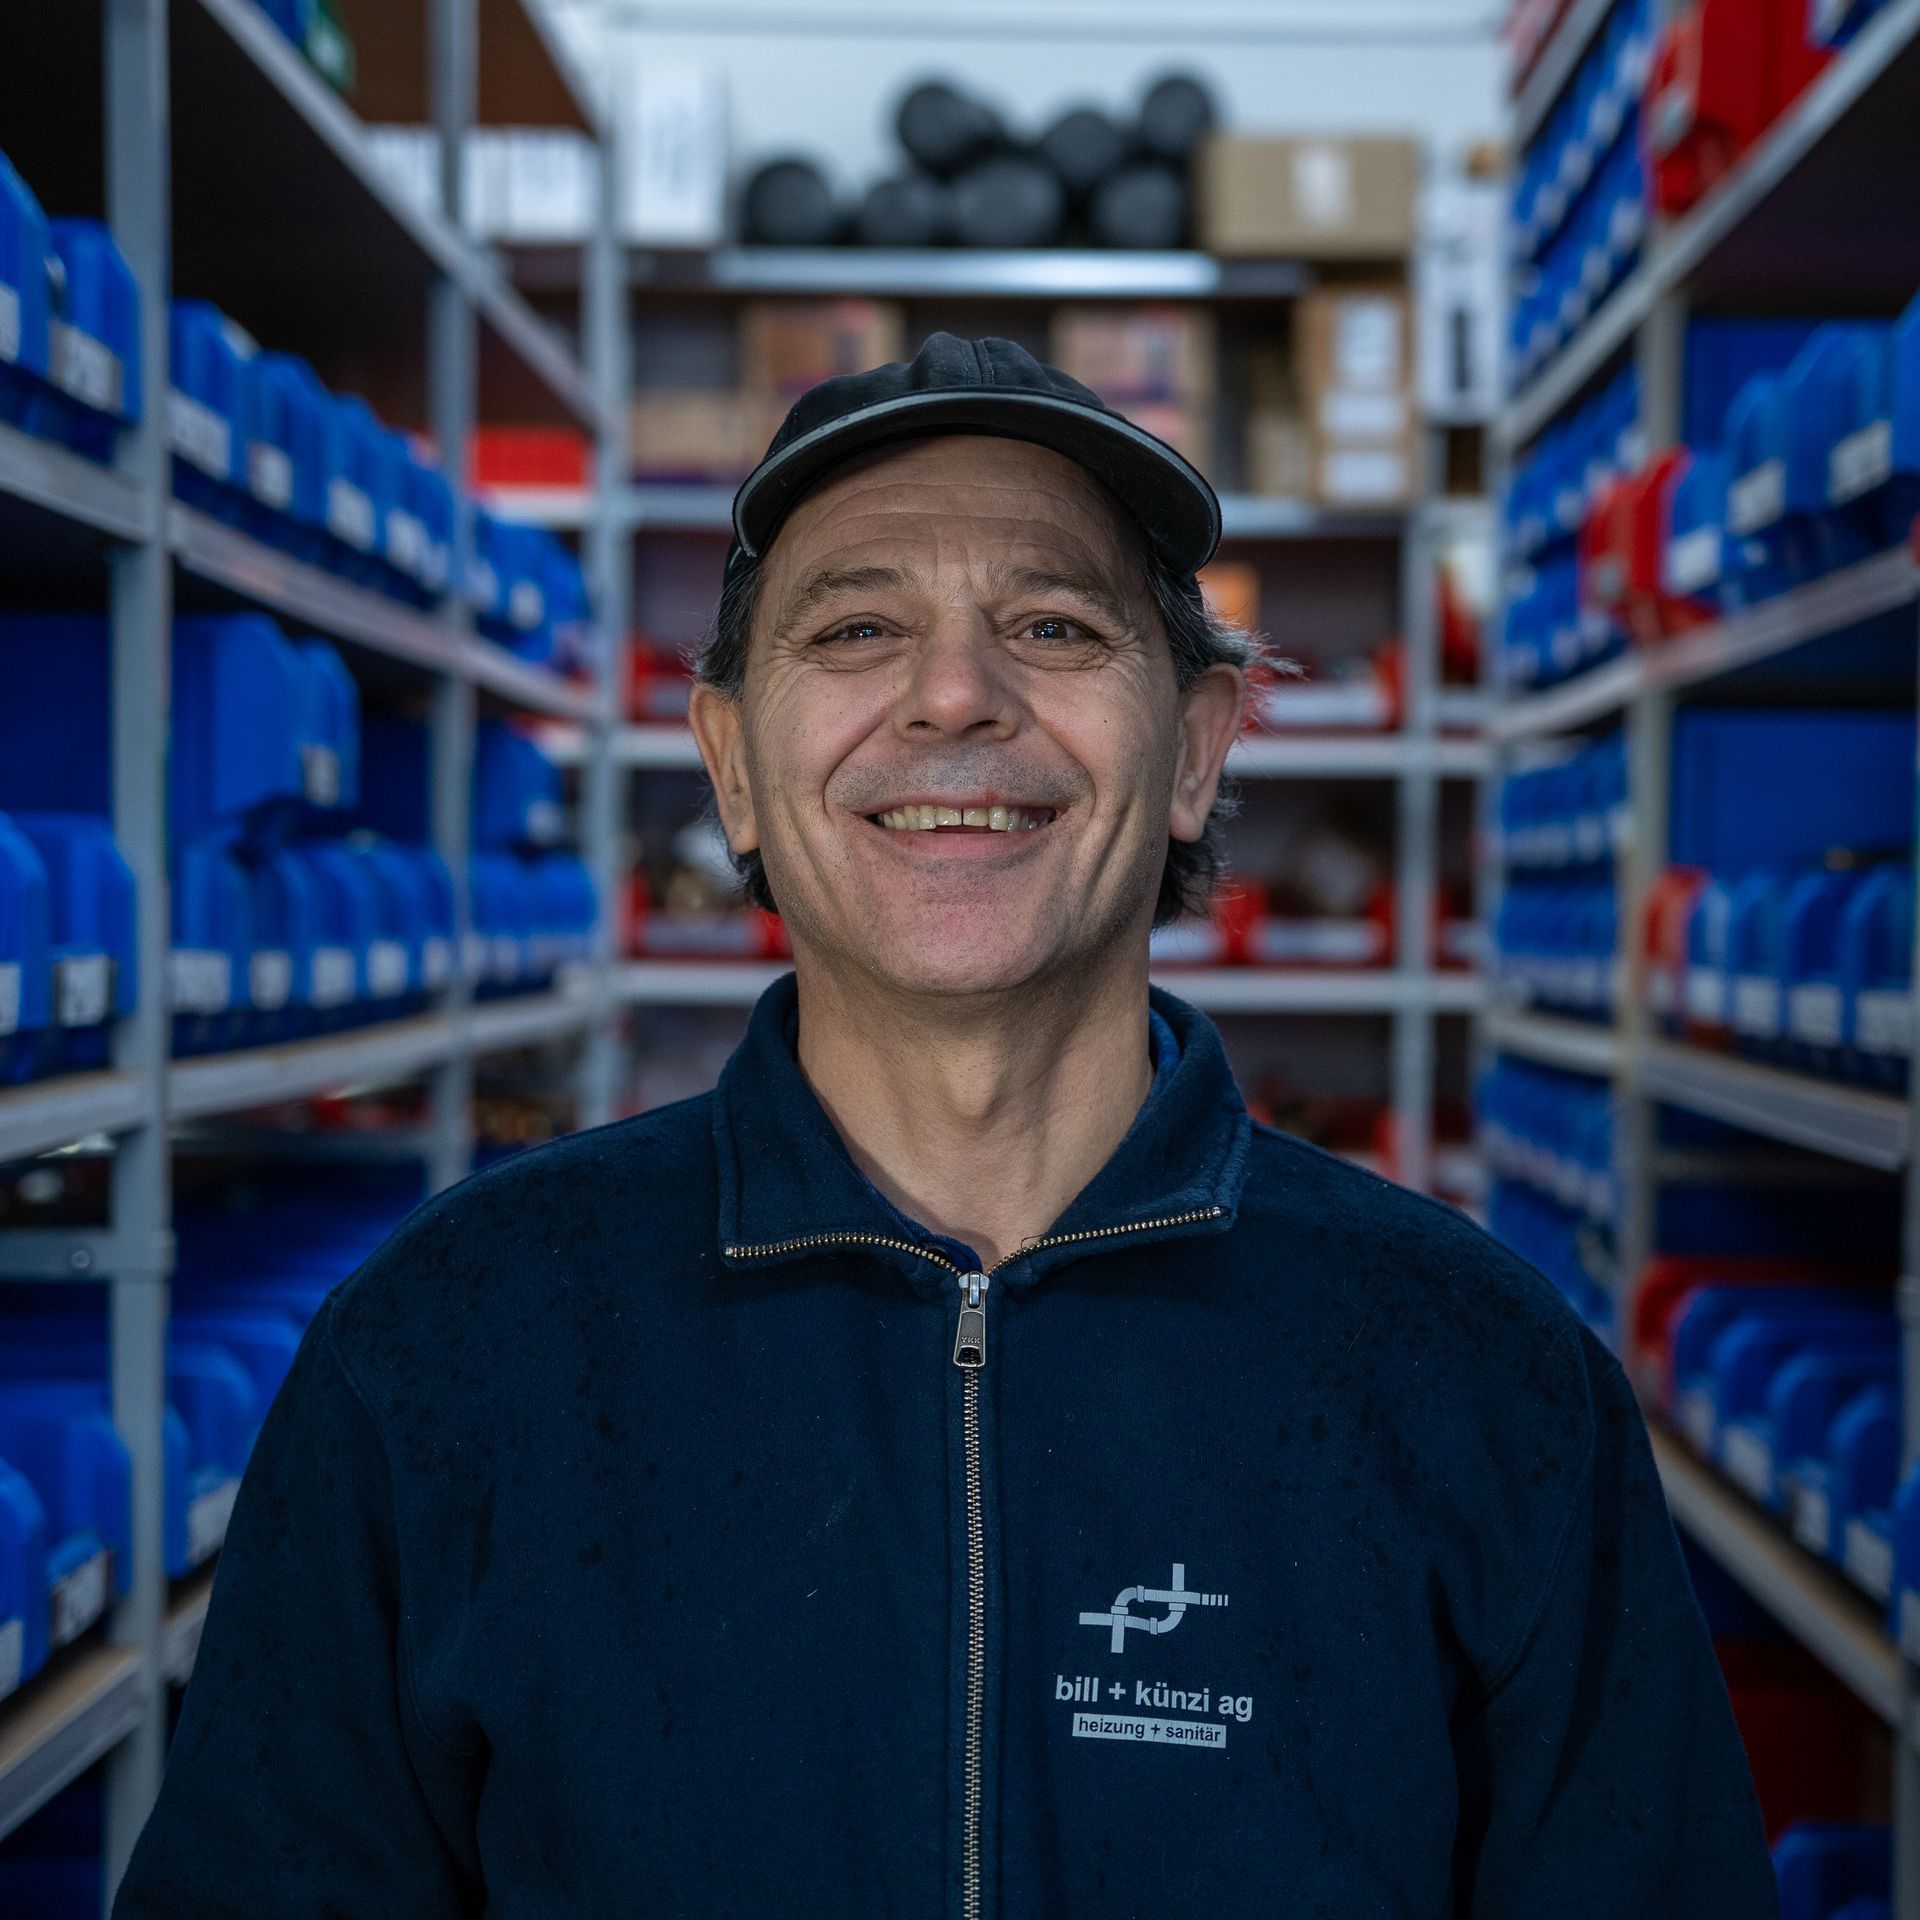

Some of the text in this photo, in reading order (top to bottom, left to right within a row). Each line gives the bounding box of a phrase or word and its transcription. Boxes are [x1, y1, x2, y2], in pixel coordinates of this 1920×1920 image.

[961, 1336, 980, 1344] YKK
[1055, 1675, 1253, 1722] bill + künzi ag
[1078, 1717, 1221, 1743] heizung + sanitär
